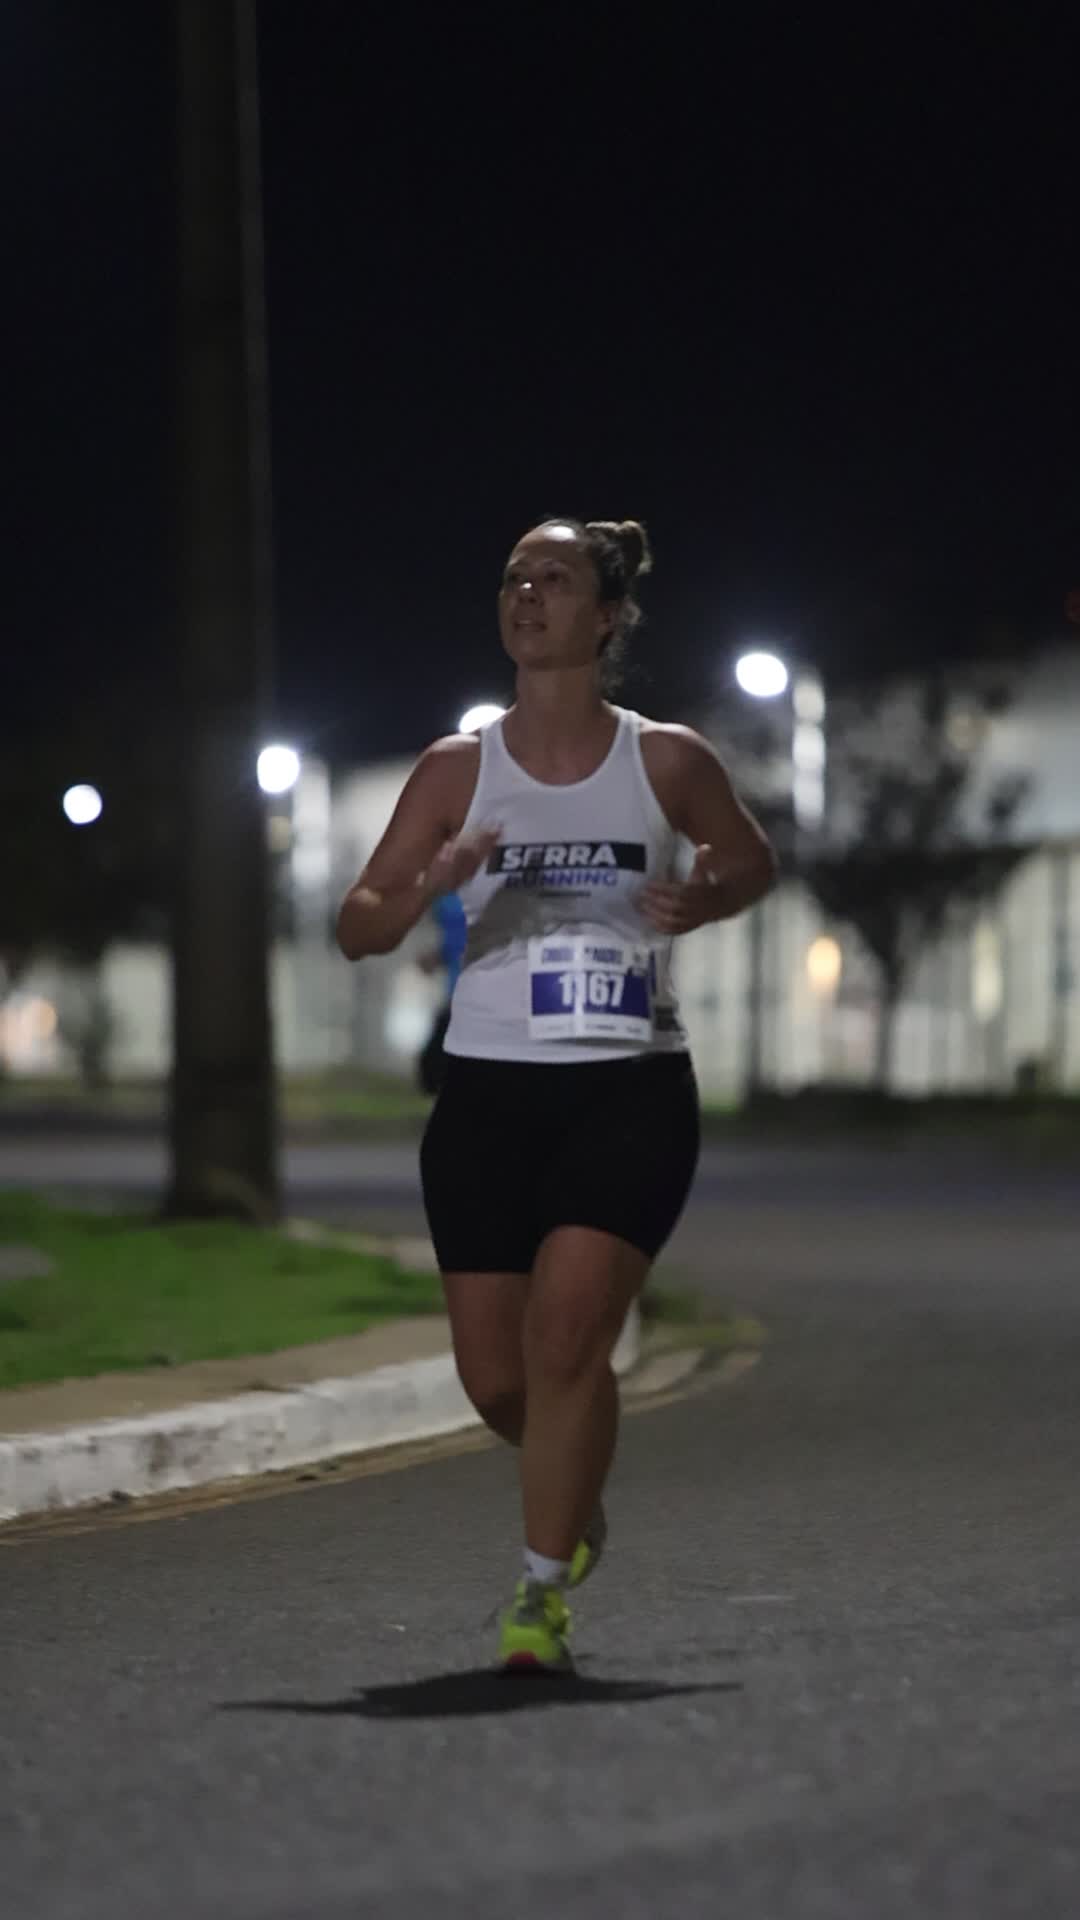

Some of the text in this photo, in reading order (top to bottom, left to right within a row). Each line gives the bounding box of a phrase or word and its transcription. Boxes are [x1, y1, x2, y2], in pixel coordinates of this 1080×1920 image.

[502, 843, 617, 870] SERRA
[505, 868, 618, 887] RUNNING
[558, 972, 625, 1008] 1167
